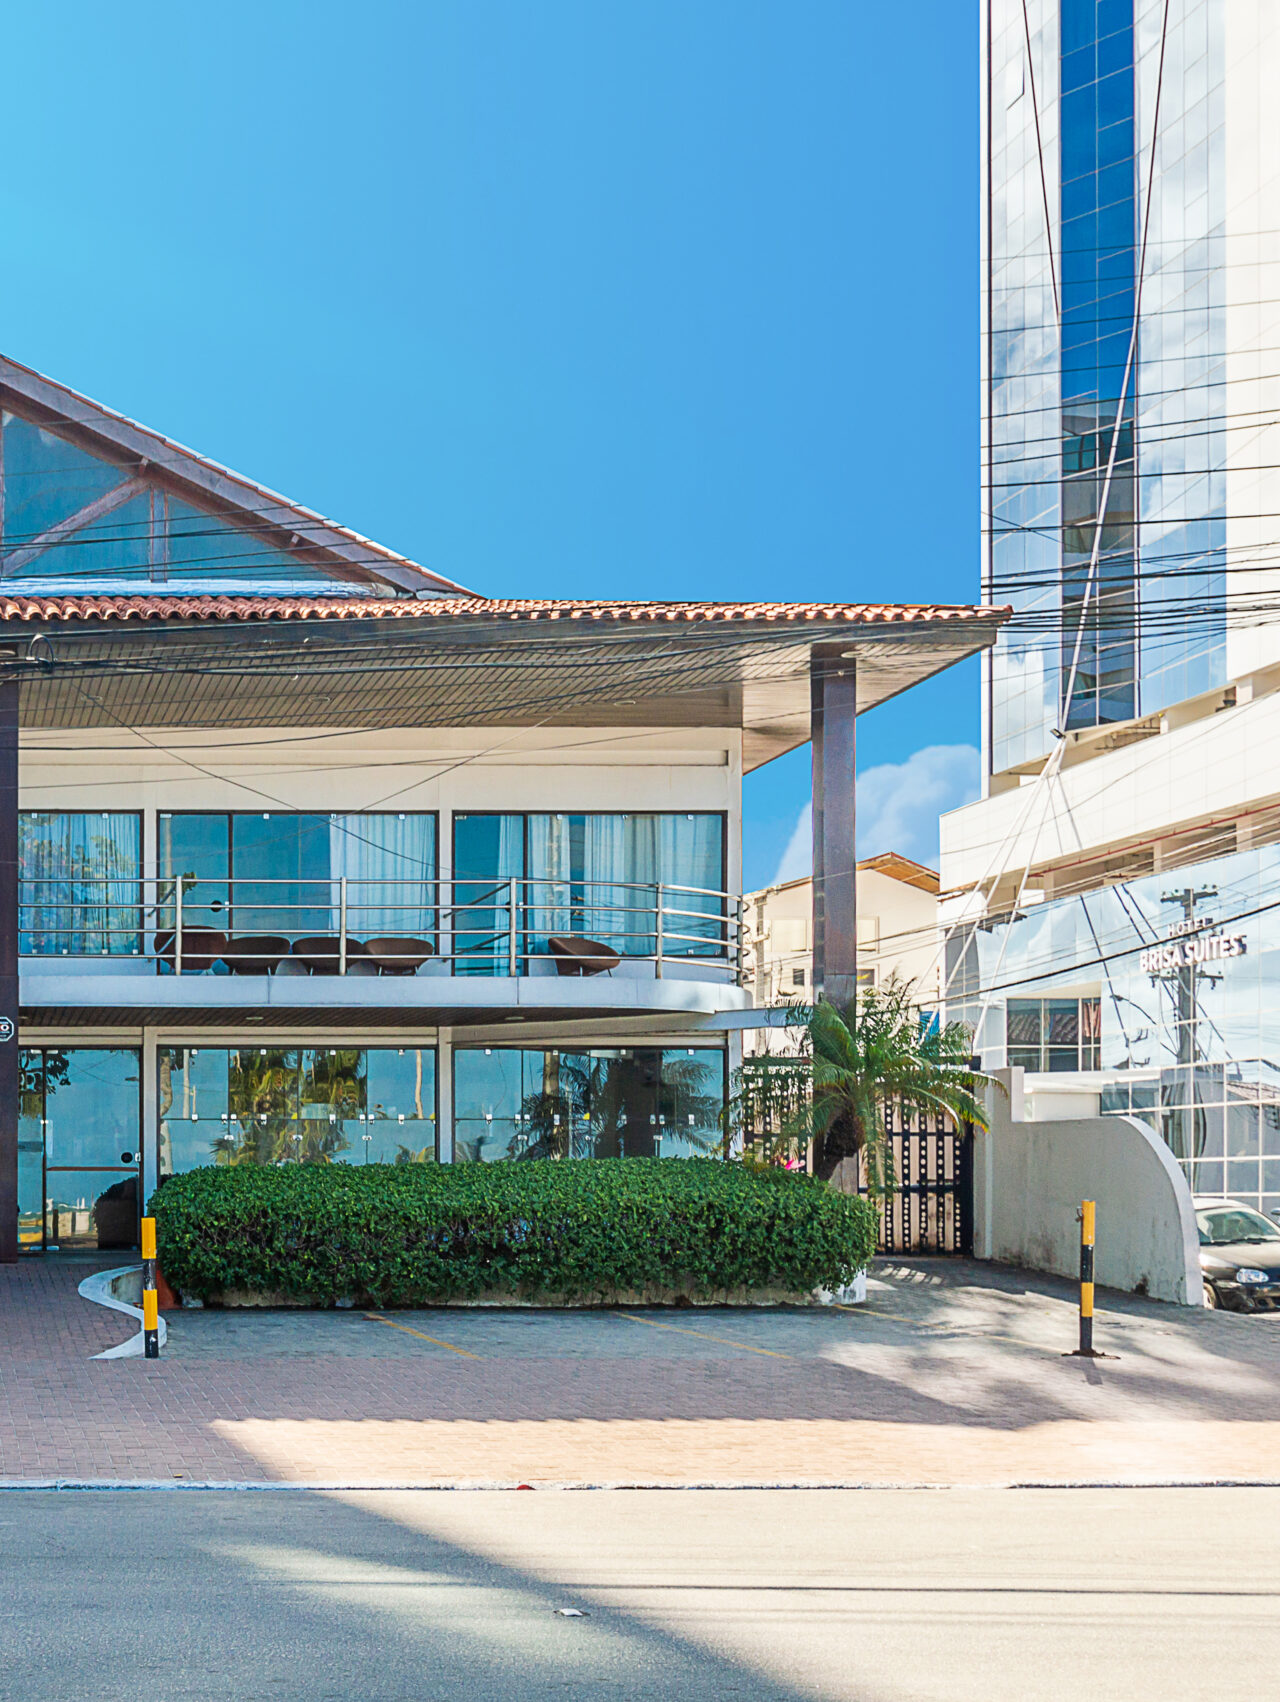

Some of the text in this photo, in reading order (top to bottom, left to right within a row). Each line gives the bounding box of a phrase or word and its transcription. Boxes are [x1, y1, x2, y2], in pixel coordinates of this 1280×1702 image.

[1167, 918, 1208, 937] HOTEL
[1140, 934, 1241, 972] BRISA SUITES
